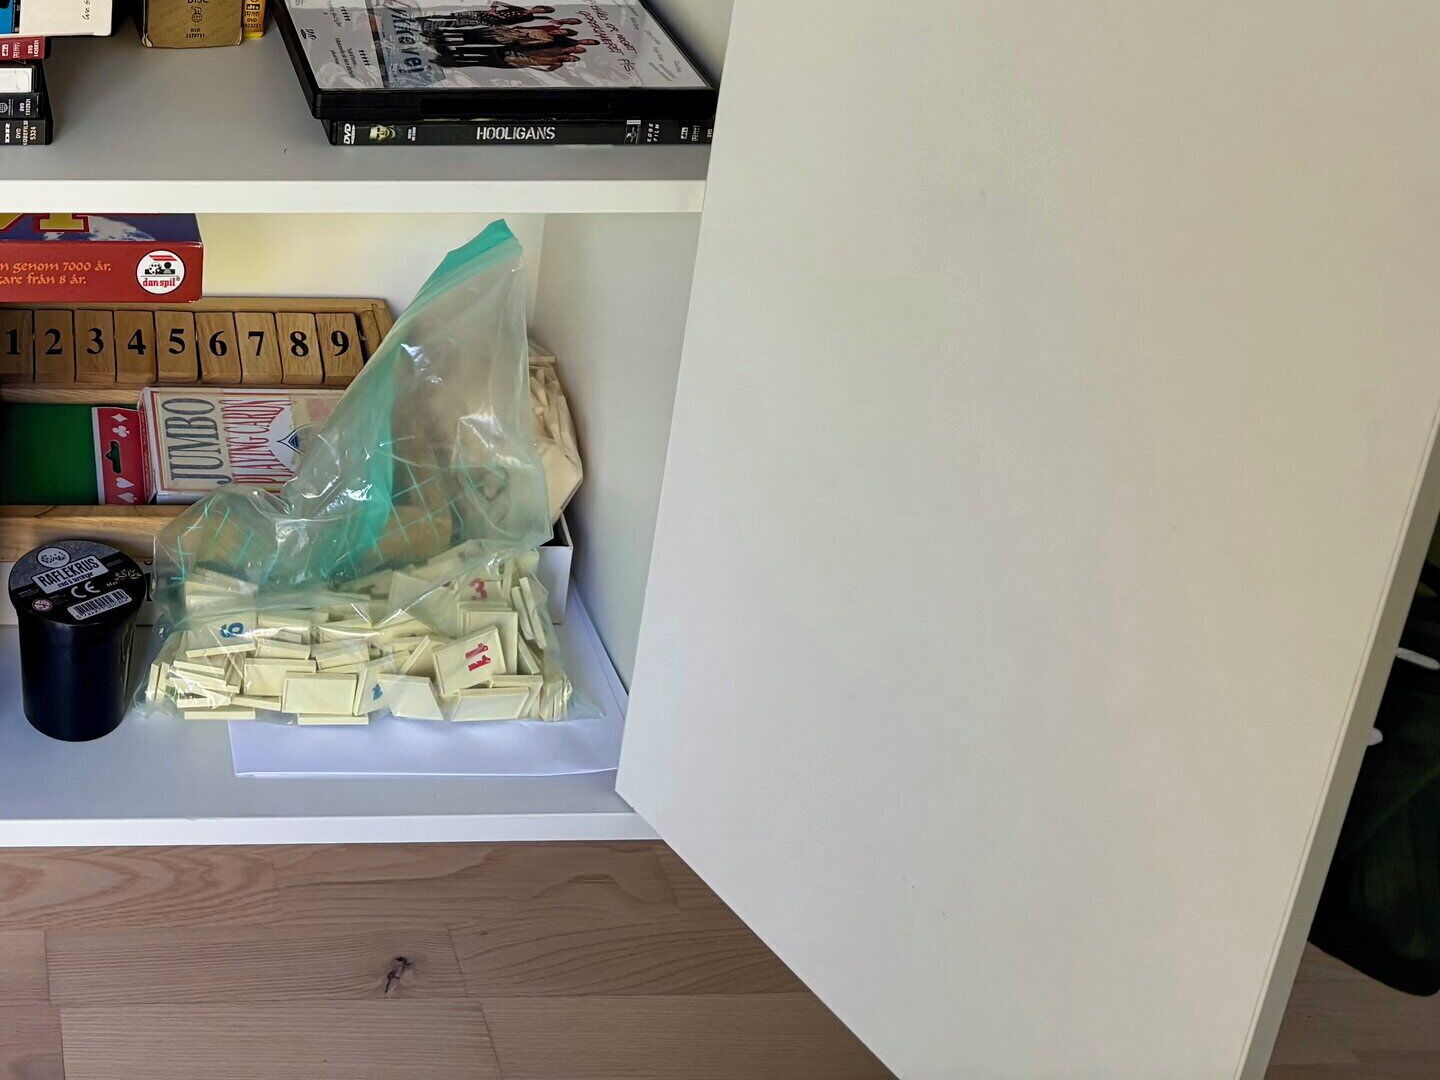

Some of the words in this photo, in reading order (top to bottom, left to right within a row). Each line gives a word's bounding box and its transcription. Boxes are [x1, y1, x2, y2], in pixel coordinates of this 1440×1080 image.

[343, 123, 351, 144] DVD
[476, 126, 556, 141] HOOLIGANS
[12, 263, 60, 275] genom
[62, 261, 92, 271] 7000
[96, 260, 112, 271] år.
[6, 329, 21, 355] 1
[45, 328, 64, 355] 2
[86, 327, 105, 355] 3
[127, 328, 147, 356] 4
[168, 327, 186, 355] 5
[209, 330, 228, 357] 6
[248, 330, 265, 357] 7
[290, 330, 310, 357] 8
[331, 329, 350, 357] 9
